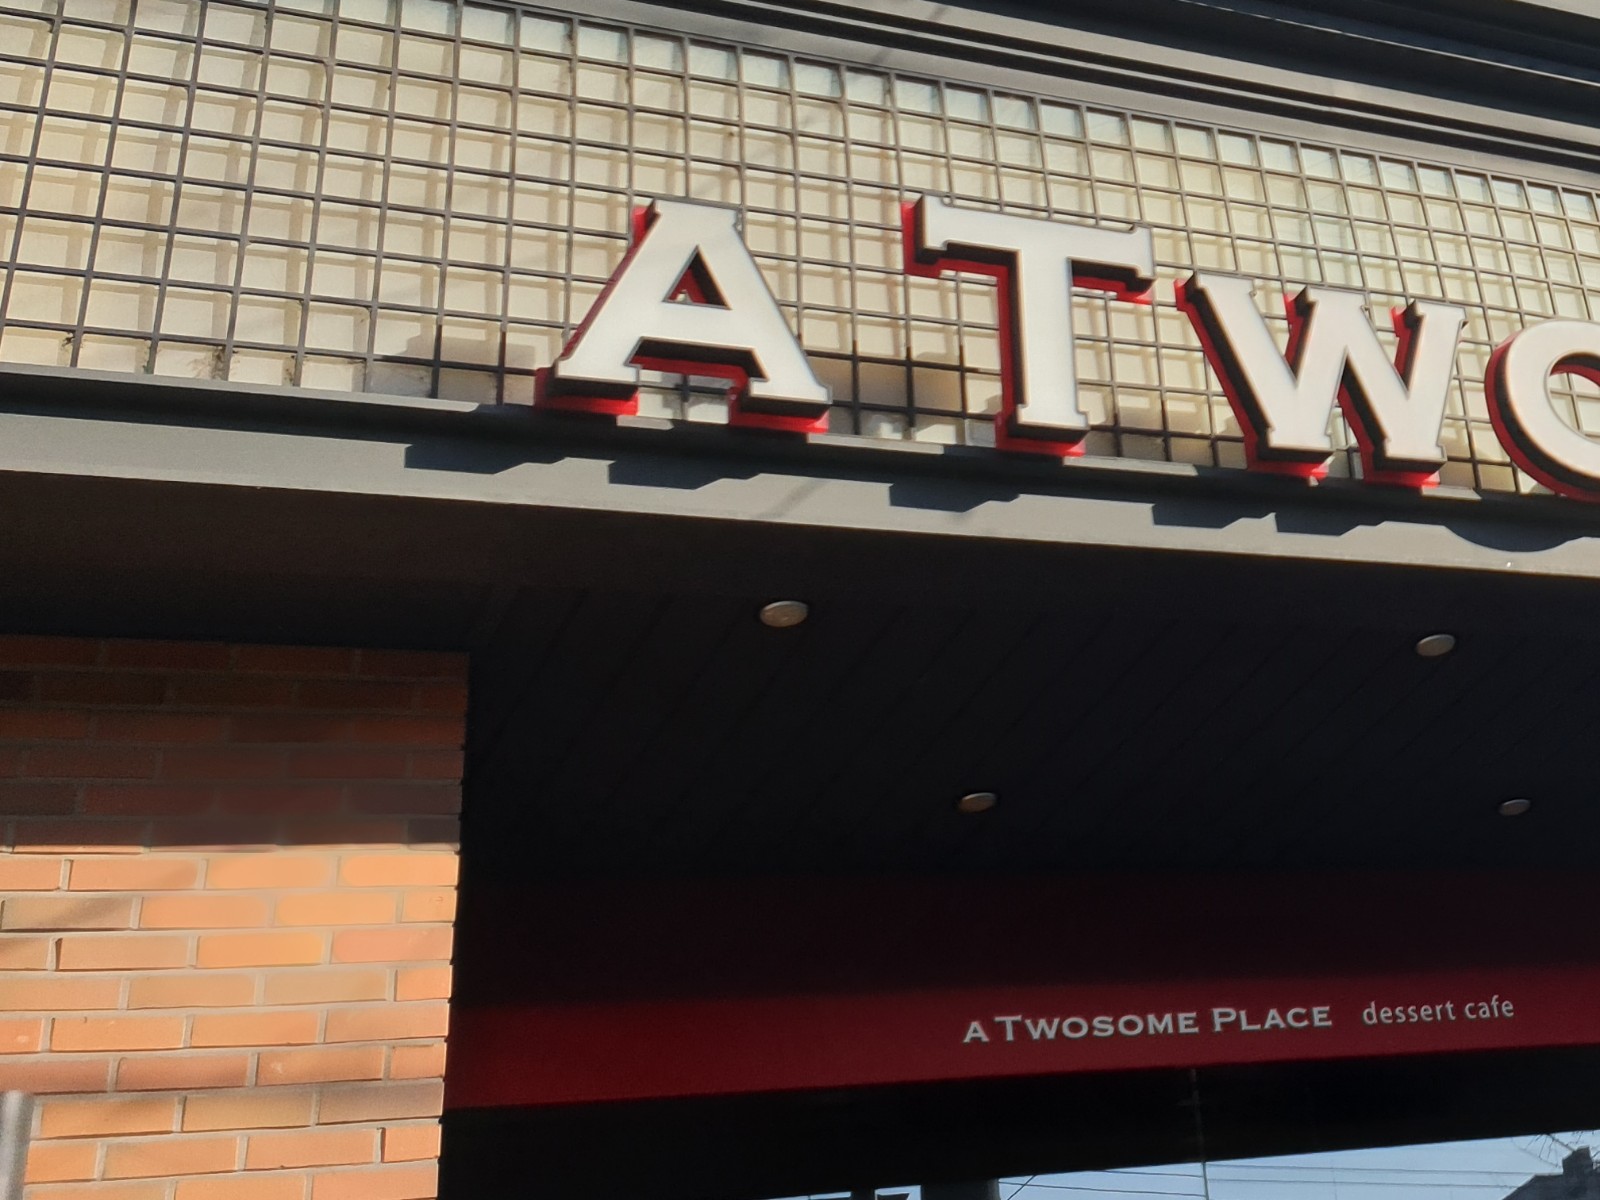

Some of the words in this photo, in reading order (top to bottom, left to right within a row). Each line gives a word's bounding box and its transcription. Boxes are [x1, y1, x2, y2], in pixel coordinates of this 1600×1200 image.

[545, 200, 832, 426] A
[963, 1020, 989, 1044] A
[994, 1010, 1200, 1042] TWOSOME
[1211, 1005, 1333, 1034] PLACE
[1362, 998, 1456, 1027] dessert
[1463, 995, 1515, 1020] cafe
